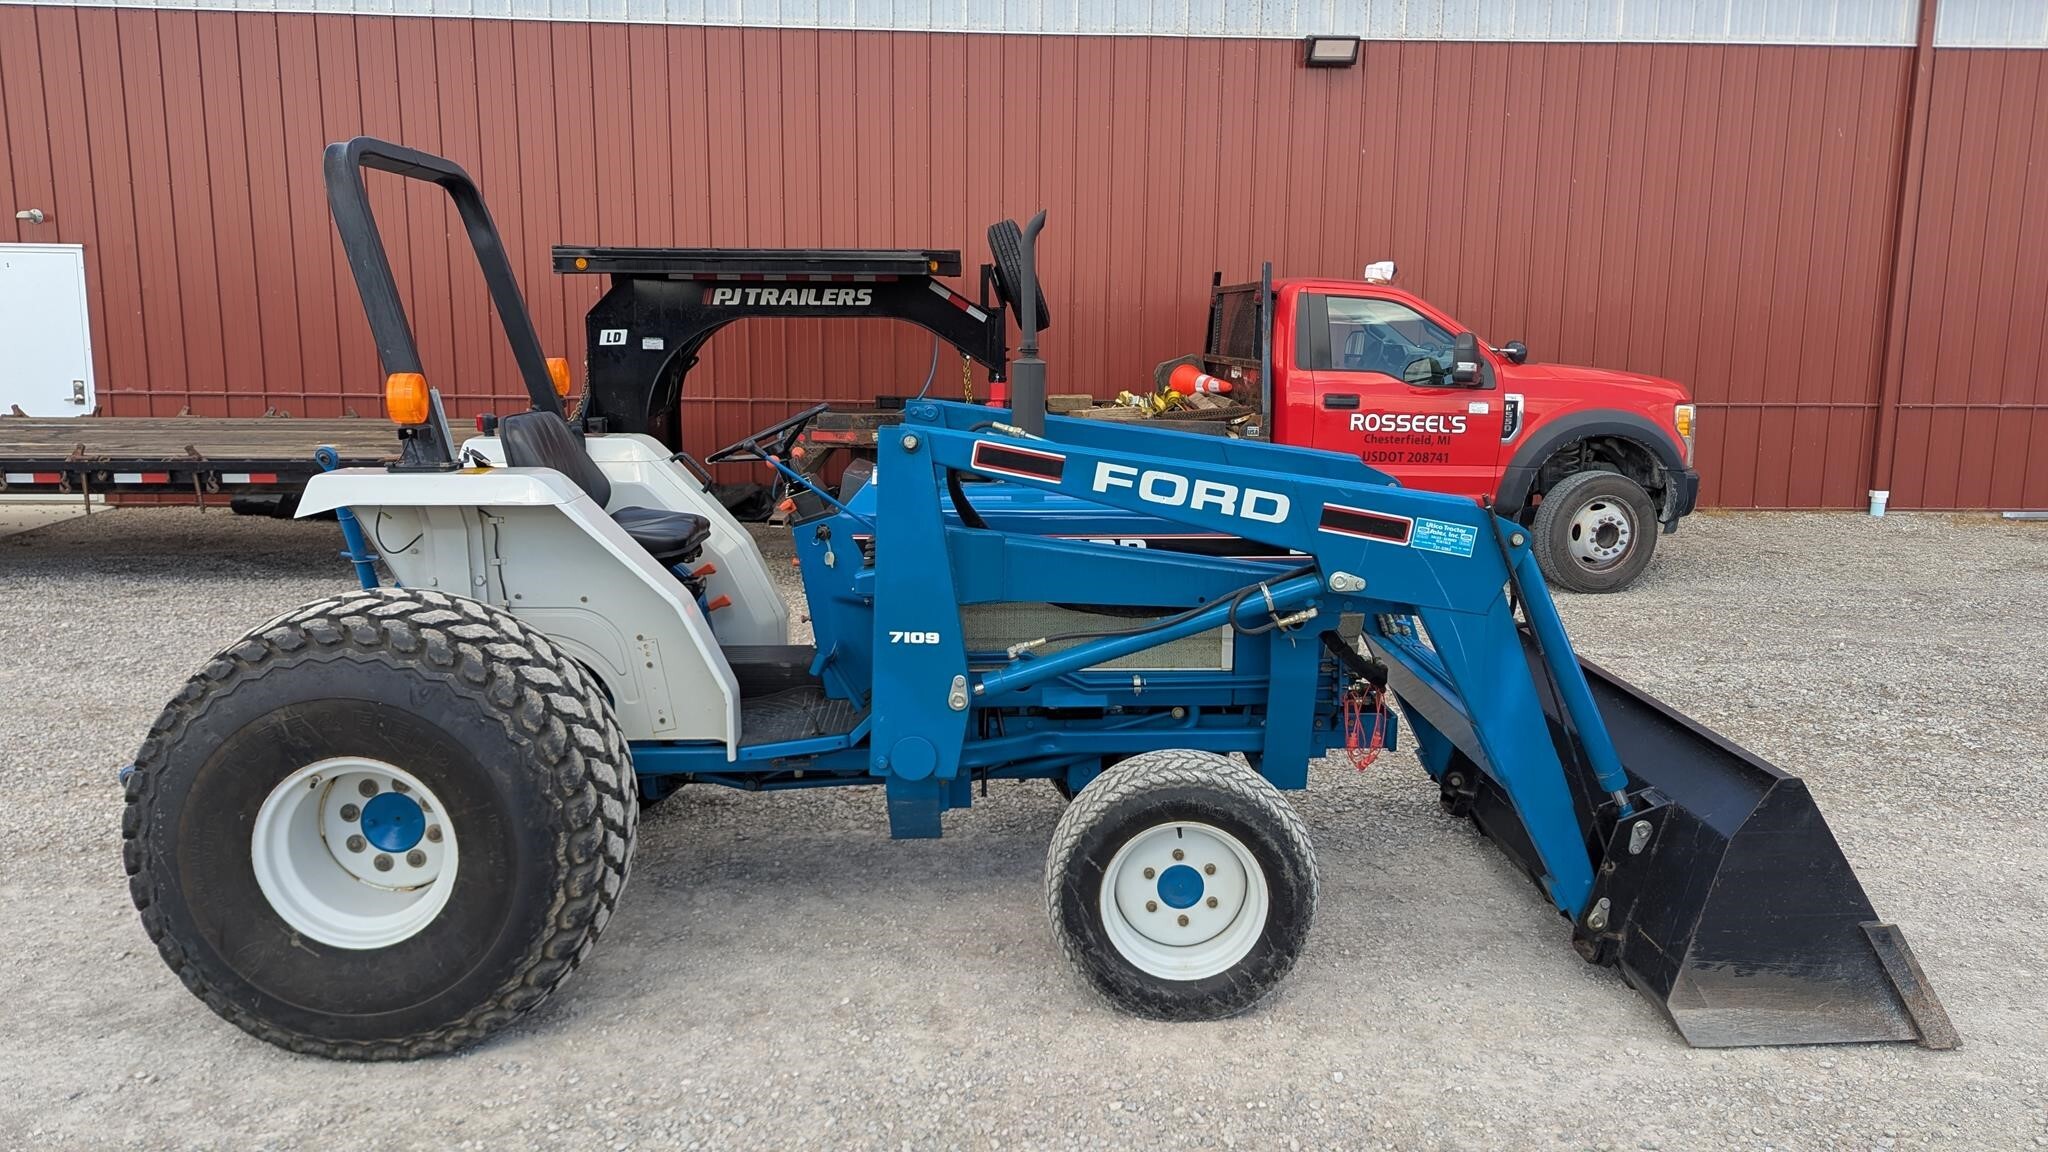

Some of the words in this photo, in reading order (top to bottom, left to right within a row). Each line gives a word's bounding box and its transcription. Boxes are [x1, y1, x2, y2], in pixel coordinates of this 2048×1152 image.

[712, 288, 740, 306] PJ
[746, 288, 872, 305] TRAILERS
[606, 332, 622, 343] LD
[1350, 413, 1467, 434] ROSSEEL'S
[1364, 433, 1435, 447] Chesterfield,
[1437, 436, 1451, 446] MI
[1362, 451, 1405, 463] USDOT
[1407, 452, 1449, 464] 208741
[1092, 461, 1290, 524] FORD
[1444, 524, 1467, 534] Tractor
[888, 631, 940, 644] 7109
